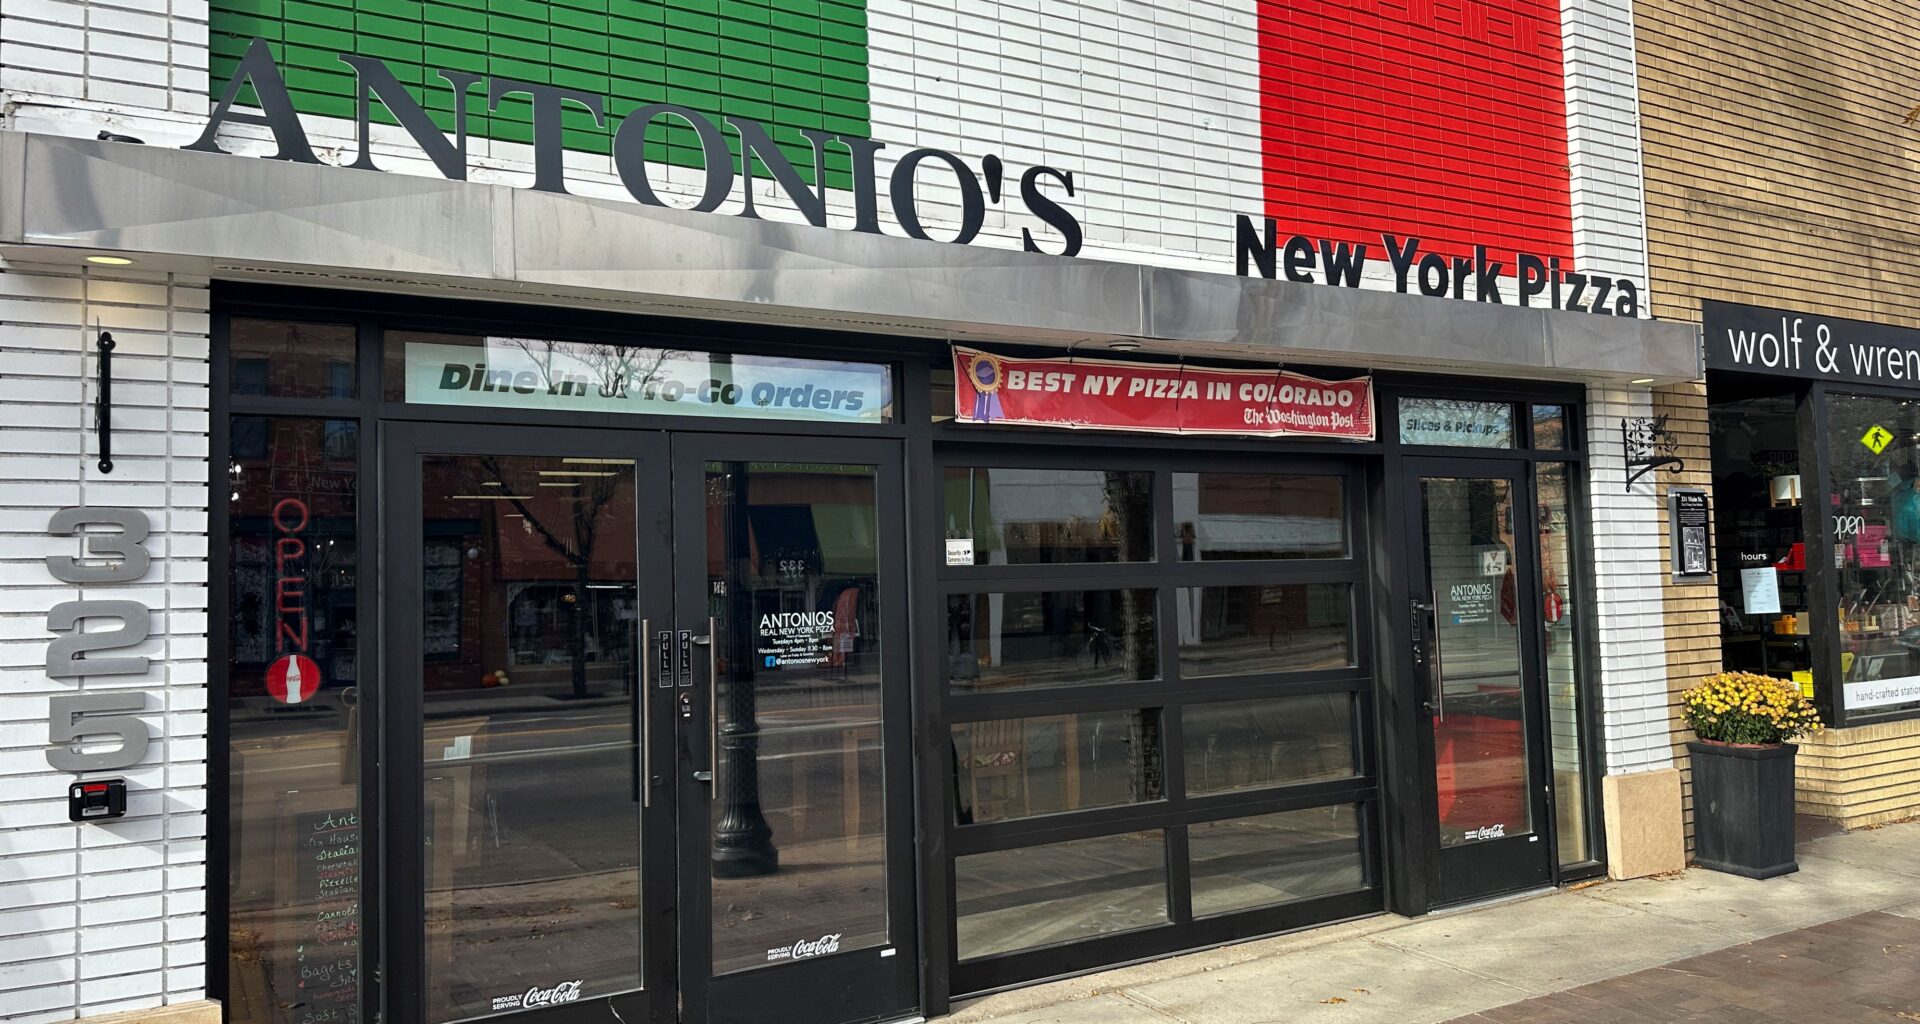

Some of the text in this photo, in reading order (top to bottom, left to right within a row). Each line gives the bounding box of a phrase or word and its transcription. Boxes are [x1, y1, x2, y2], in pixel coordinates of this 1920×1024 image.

[180, 37, 1083, 258] ANTONIO'S
[1236, 214, 1637, 318] New York Pizza
[1727, 316, 1920, 380] wolf & wren
[439, 363, 538, 394] Dine
[546, 369, 587, 396] In
[643, 375, 742, 405] To-Go
[751, 381, 864, 410] Orders
[1007, 370, 1353, 407] BEST NY PIZZA IN COLORADO
[1243, 405, 1354, 431] The Washington Post
[1406, 418, 1500, 436] Slices & Pickups
[1741, 552, 1767, 561] hours
[272, 498, 308, 652] OPEN
[1450, 584, 1491, 596] ANTONIOS
[760, 611, 834, 628] ANTONIOS
[776, 656, 829, 665] @antoniosnewyork
[1856, 684, 1920, 702] hand-crafted statio
[767, 945, 792, 954] PROUDLY
[767, 952, 790, 960] SERVING
[492, 994, 523, 1004] PROUDLY
[492, 1001, 520, 1010] SERVING
